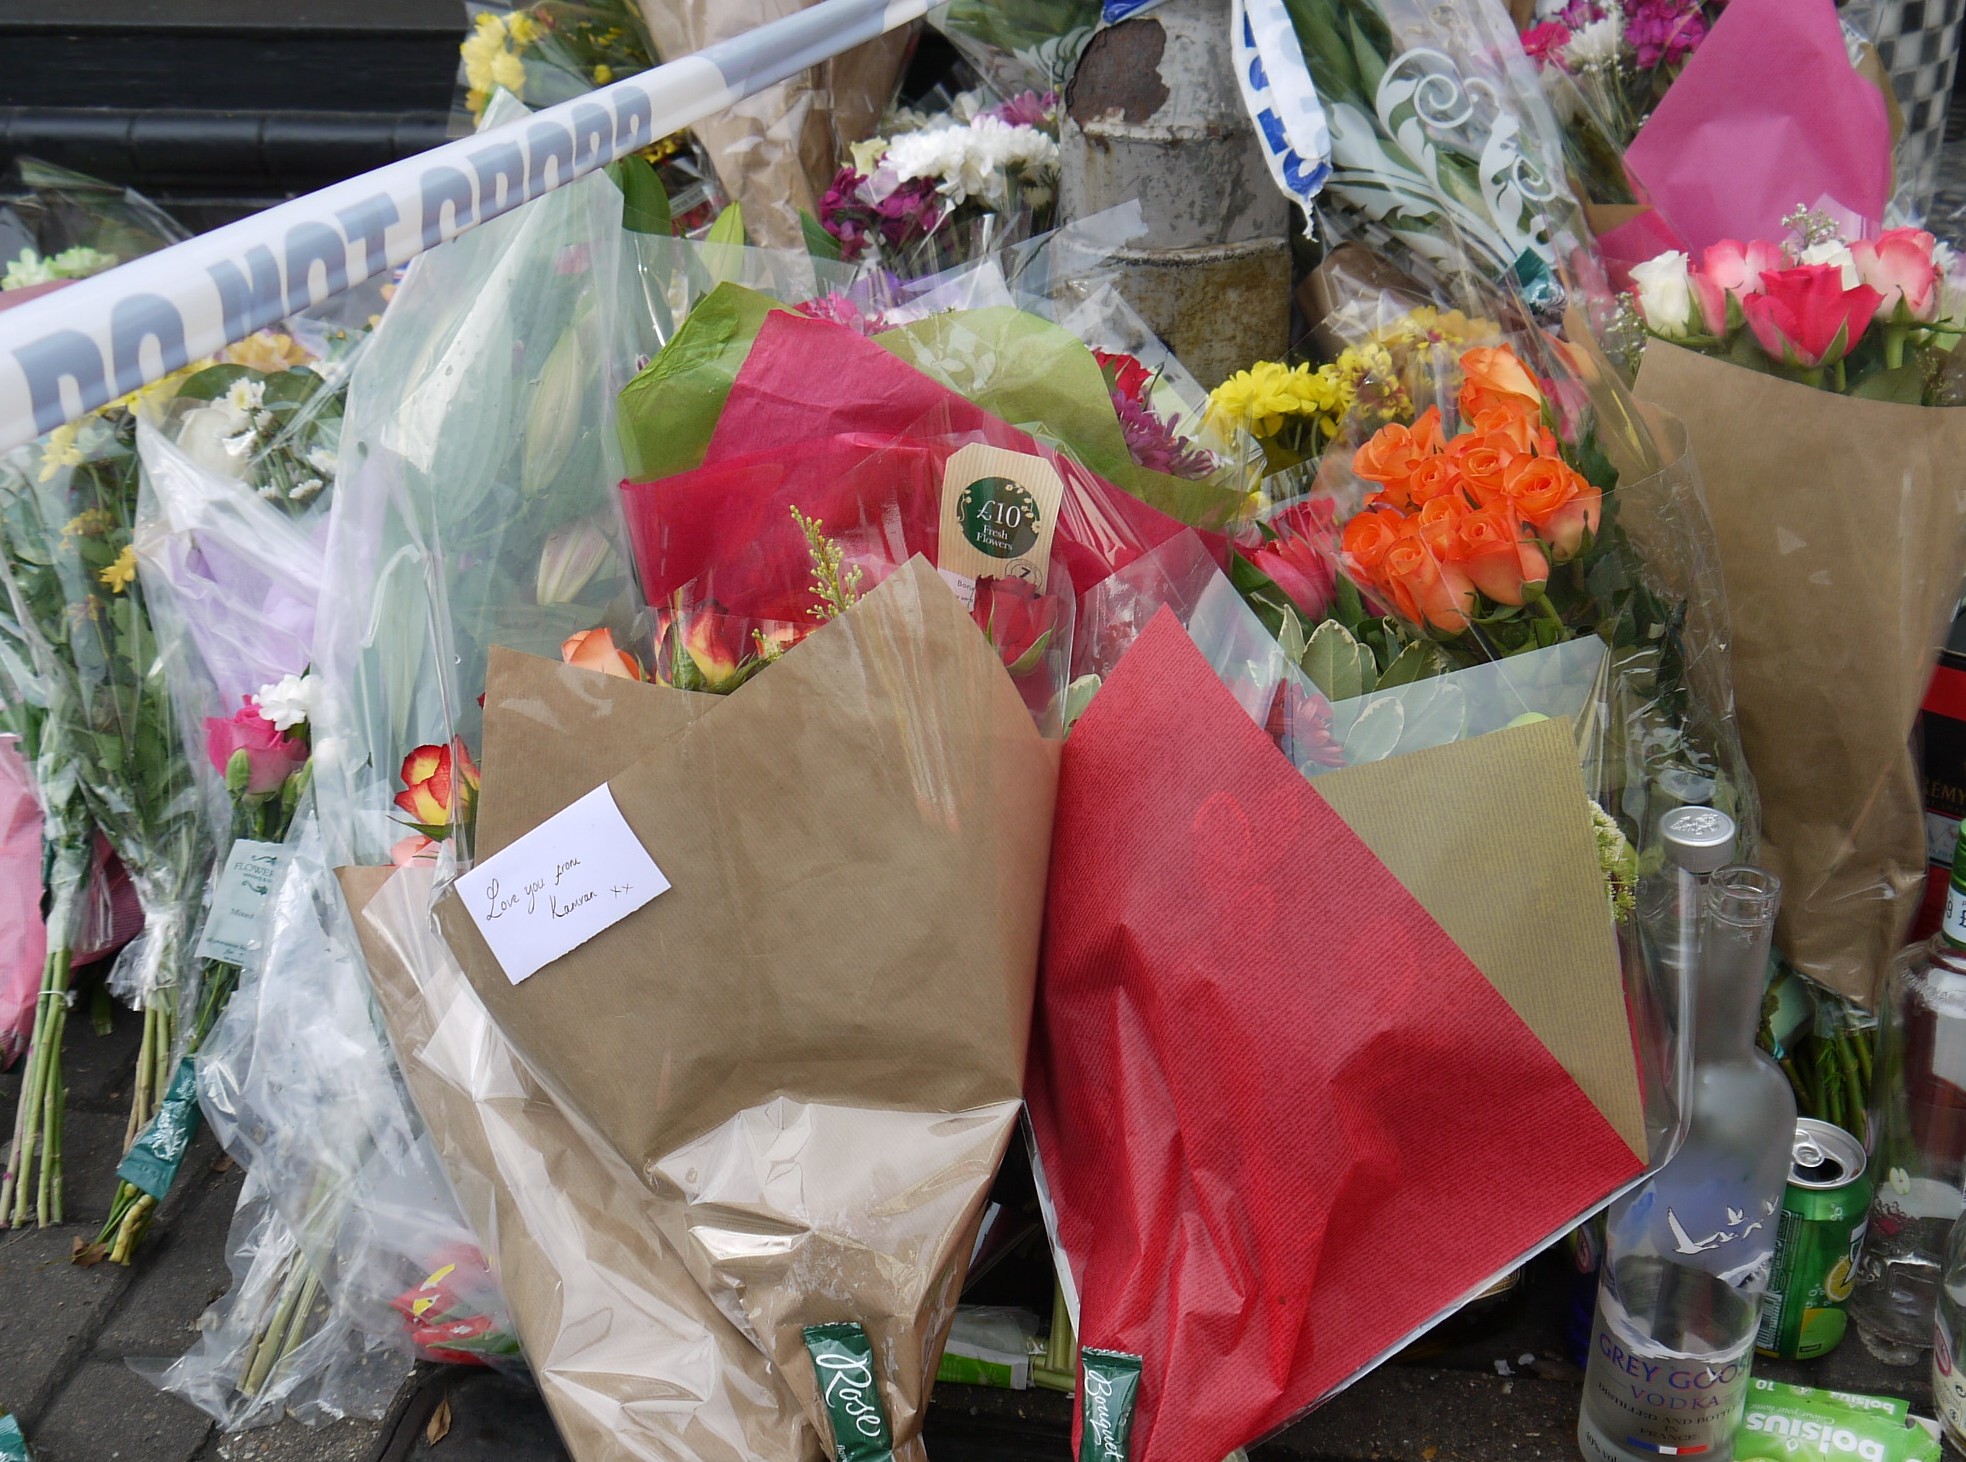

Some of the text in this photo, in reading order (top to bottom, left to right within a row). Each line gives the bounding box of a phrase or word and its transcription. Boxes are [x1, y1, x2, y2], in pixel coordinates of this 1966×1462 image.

[976, 500, 1021, 528] £10
[976, 532, 1013, 551] Flowers
[983, 524, 1008, 540] Fresh
[486, 858, 581, 921] Love you from
[1599, 1333, 1660, 1383] GREY
[815, 1354, 880, 1437] Rose
[1630, 1384, 1720, 1411] VODKA
[1829, 1391, 1895, 1416] bolsius
[1084, 1369, 1124, 1462] Bouquet
[1663, 1416, 1692, 1426] AND
[1640, 1427, 1697, 1441] FRANCE
[1745, 1412, 1885, 1462] bolsius
